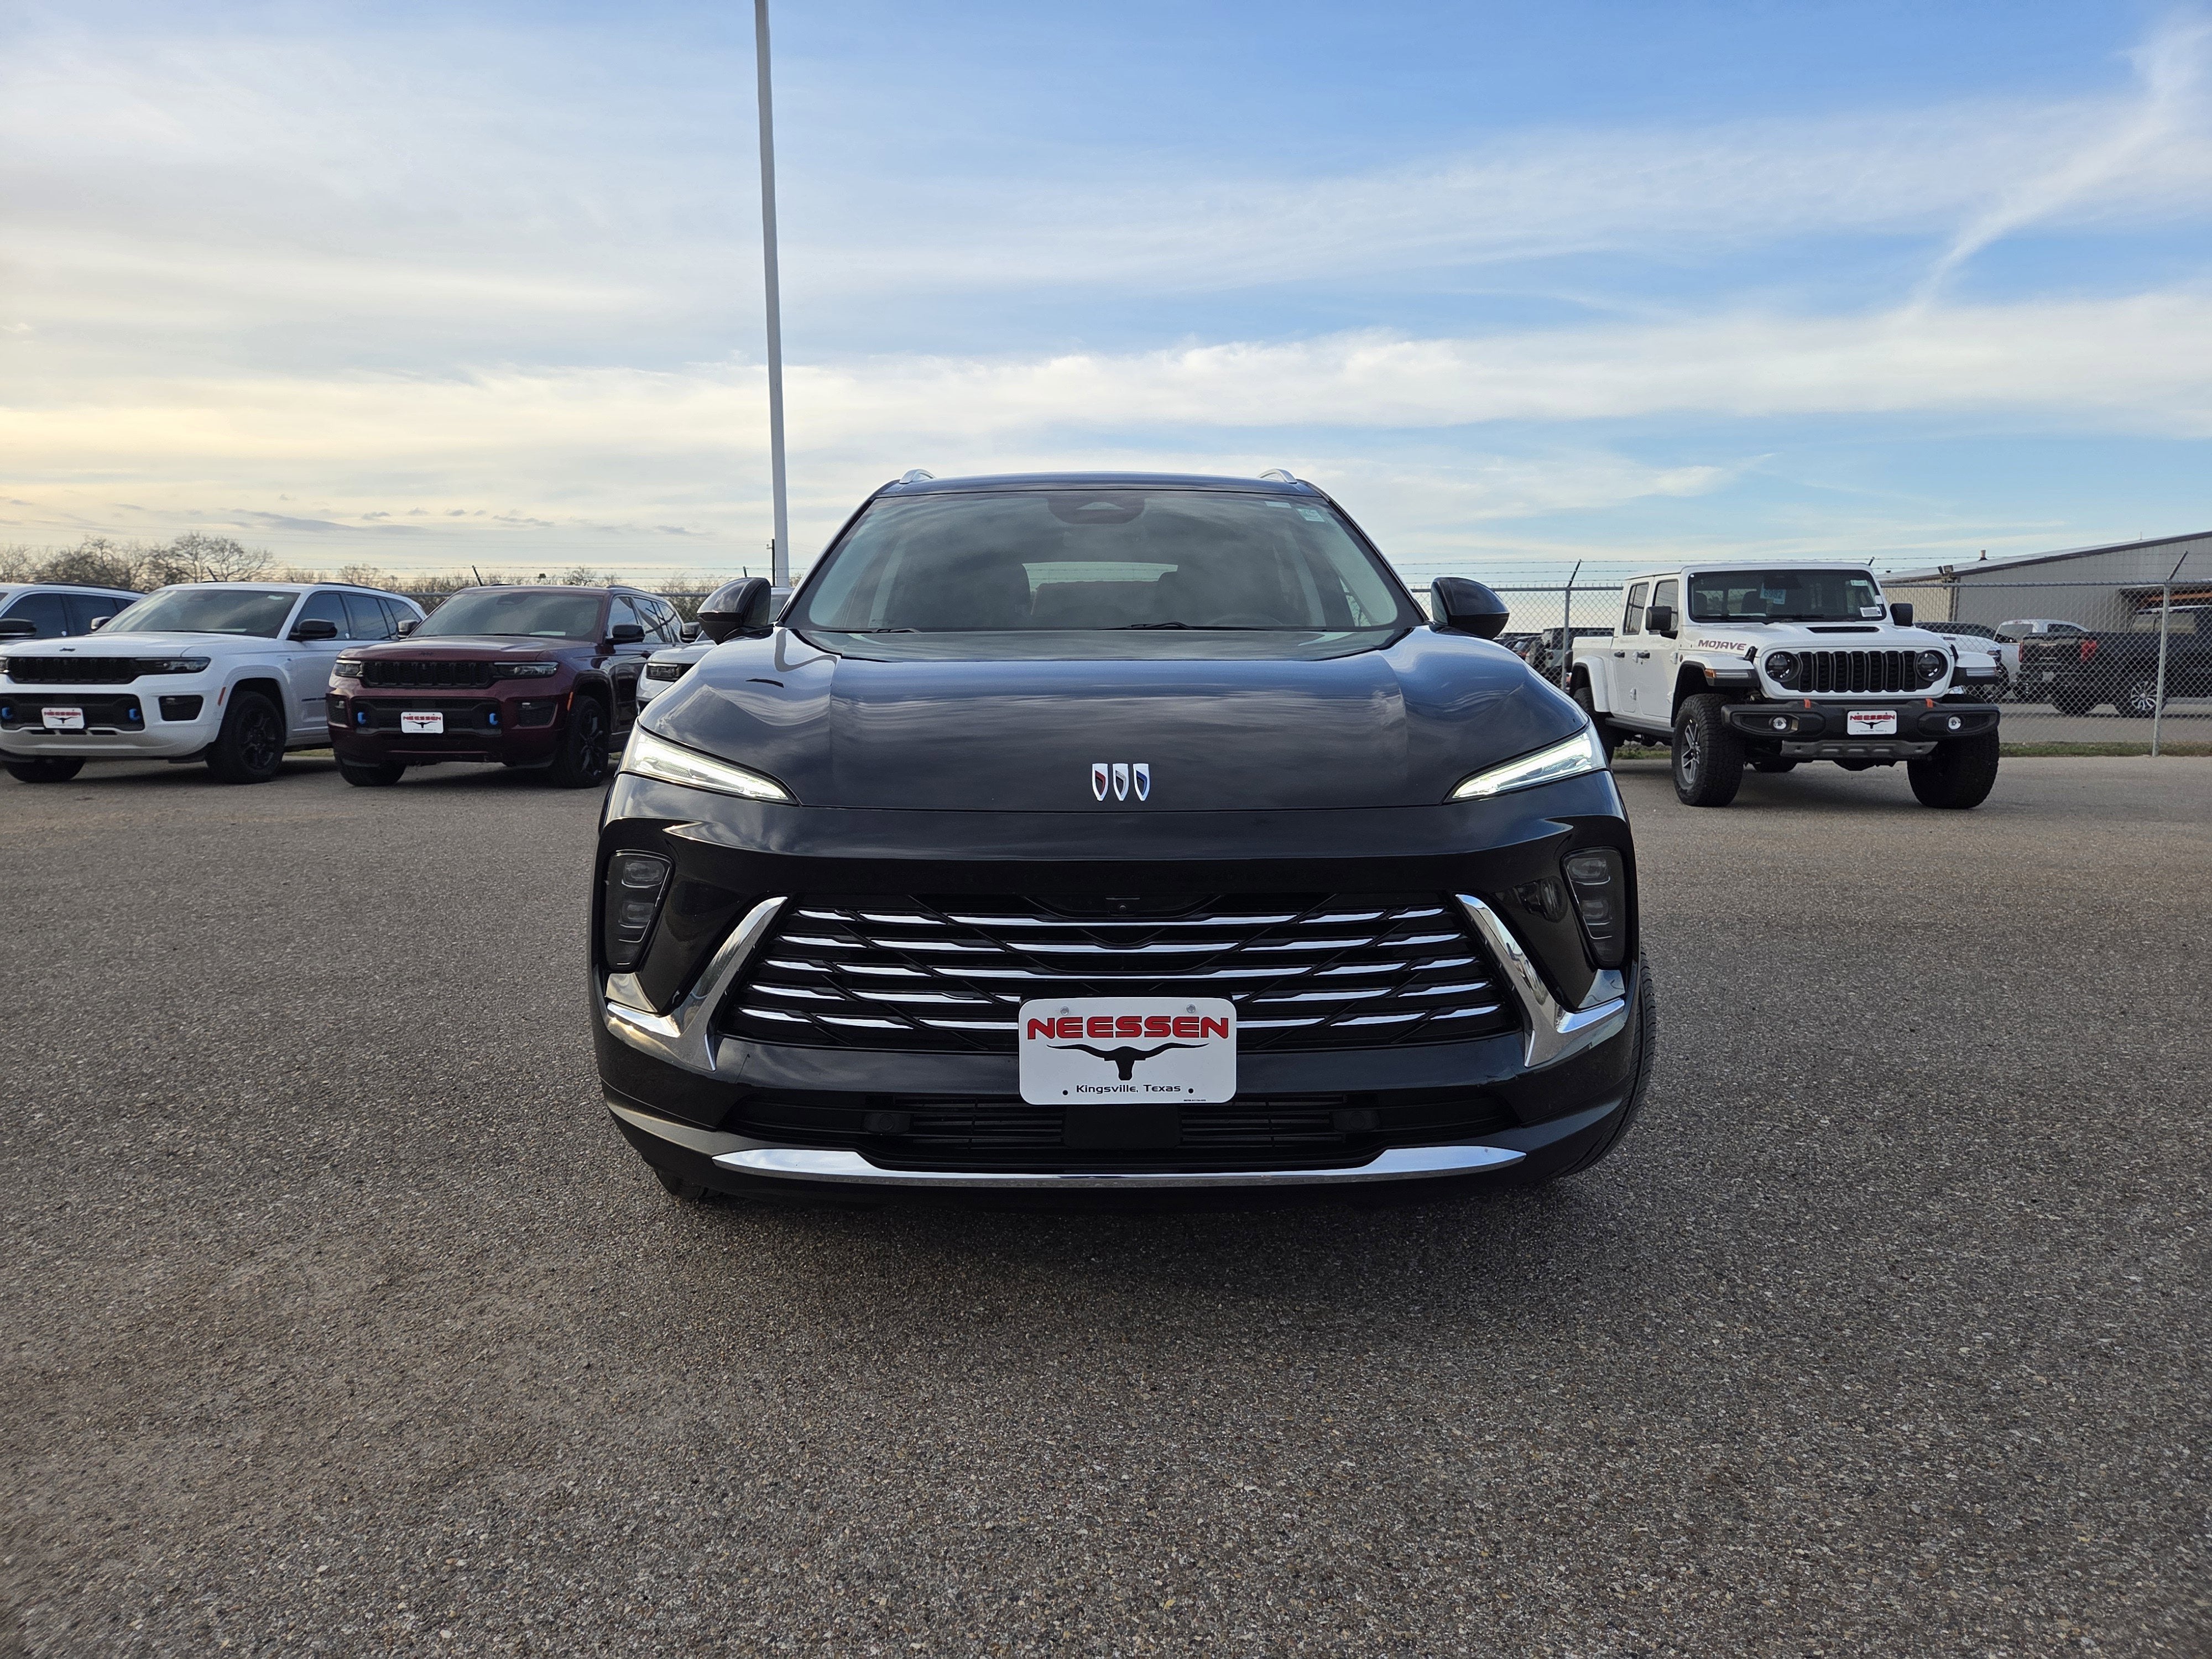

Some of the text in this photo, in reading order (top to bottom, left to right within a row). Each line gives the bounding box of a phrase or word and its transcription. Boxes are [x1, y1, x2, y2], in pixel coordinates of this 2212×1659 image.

[1698, 640, 1747, 650] MOJAVE
[1027, 1016, 1229, 1040] NEESSEN
[1076, 1084, 1139, 1094] Kingsville,
